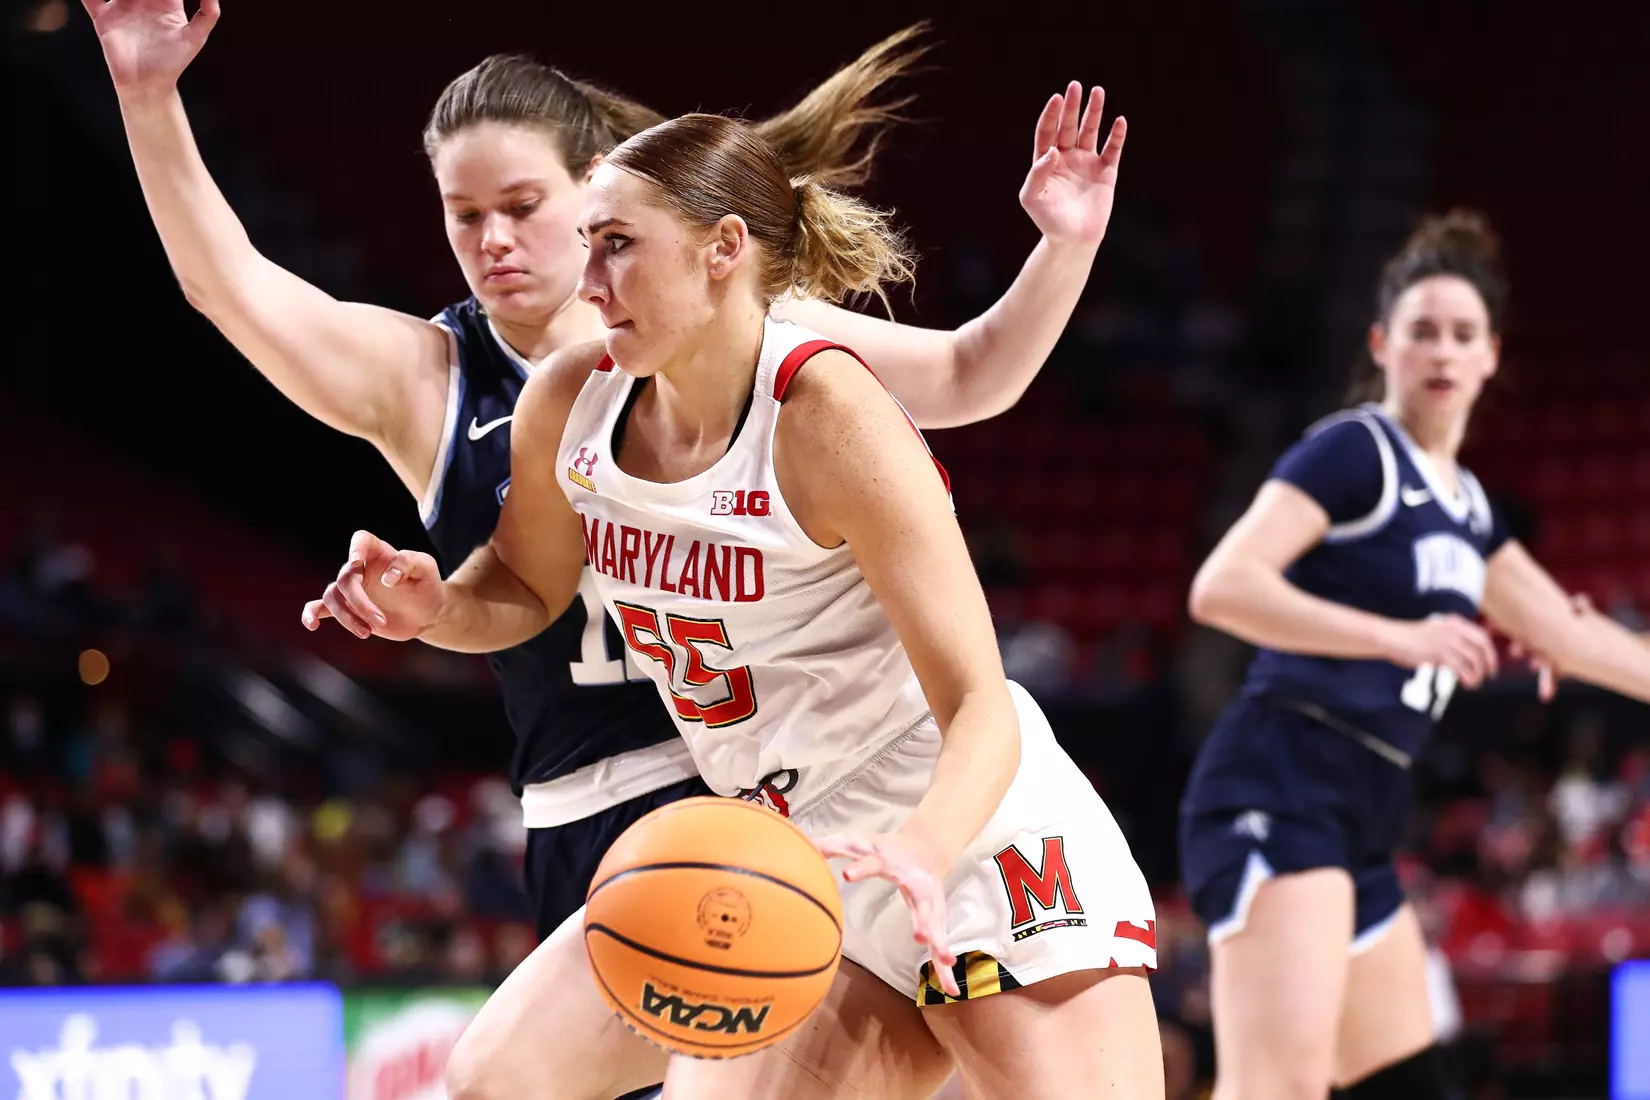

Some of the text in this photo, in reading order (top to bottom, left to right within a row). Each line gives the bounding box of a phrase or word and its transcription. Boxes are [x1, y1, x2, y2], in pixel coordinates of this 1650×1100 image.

[581, 513, 765, 602] MARYLAND
[614, 600, 758, 729] 55
[993, 836, 1085, 930] M
[641, 981, 771, 1034] NCAA
